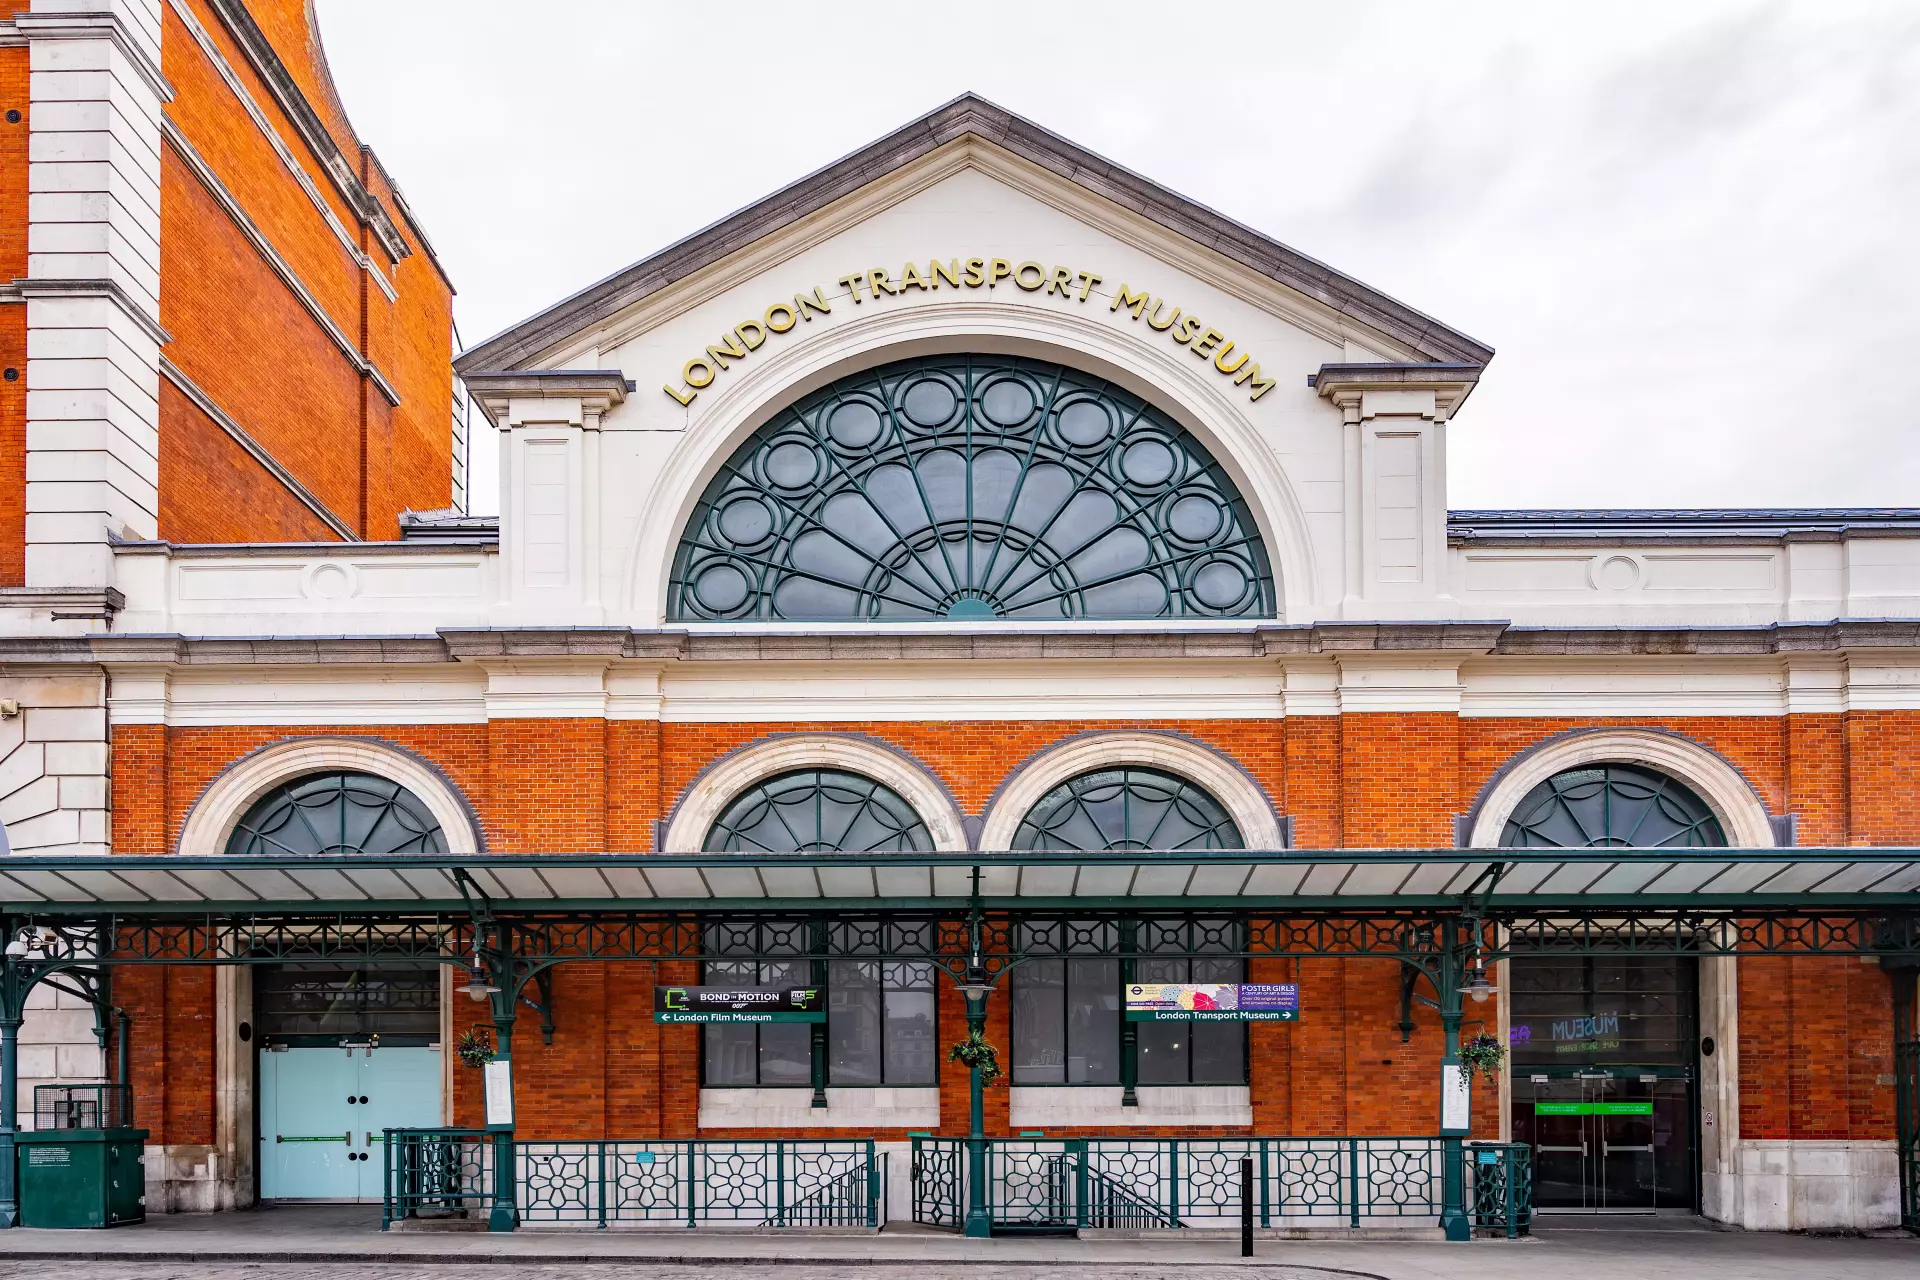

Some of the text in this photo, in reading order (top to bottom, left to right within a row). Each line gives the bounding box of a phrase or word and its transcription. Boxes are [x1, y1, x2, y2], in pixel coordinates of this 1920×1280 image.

[663, 257, 1277, 407] LONDON TRANSPORT MUSEUM
[700, 993, 731, 1001] BOND
[738, 993, 780, 1001] MOTION
[673, 1013, 772, 1021] London Film Museum
[1155, 1011, 1279, 1021] London Transport Museum
